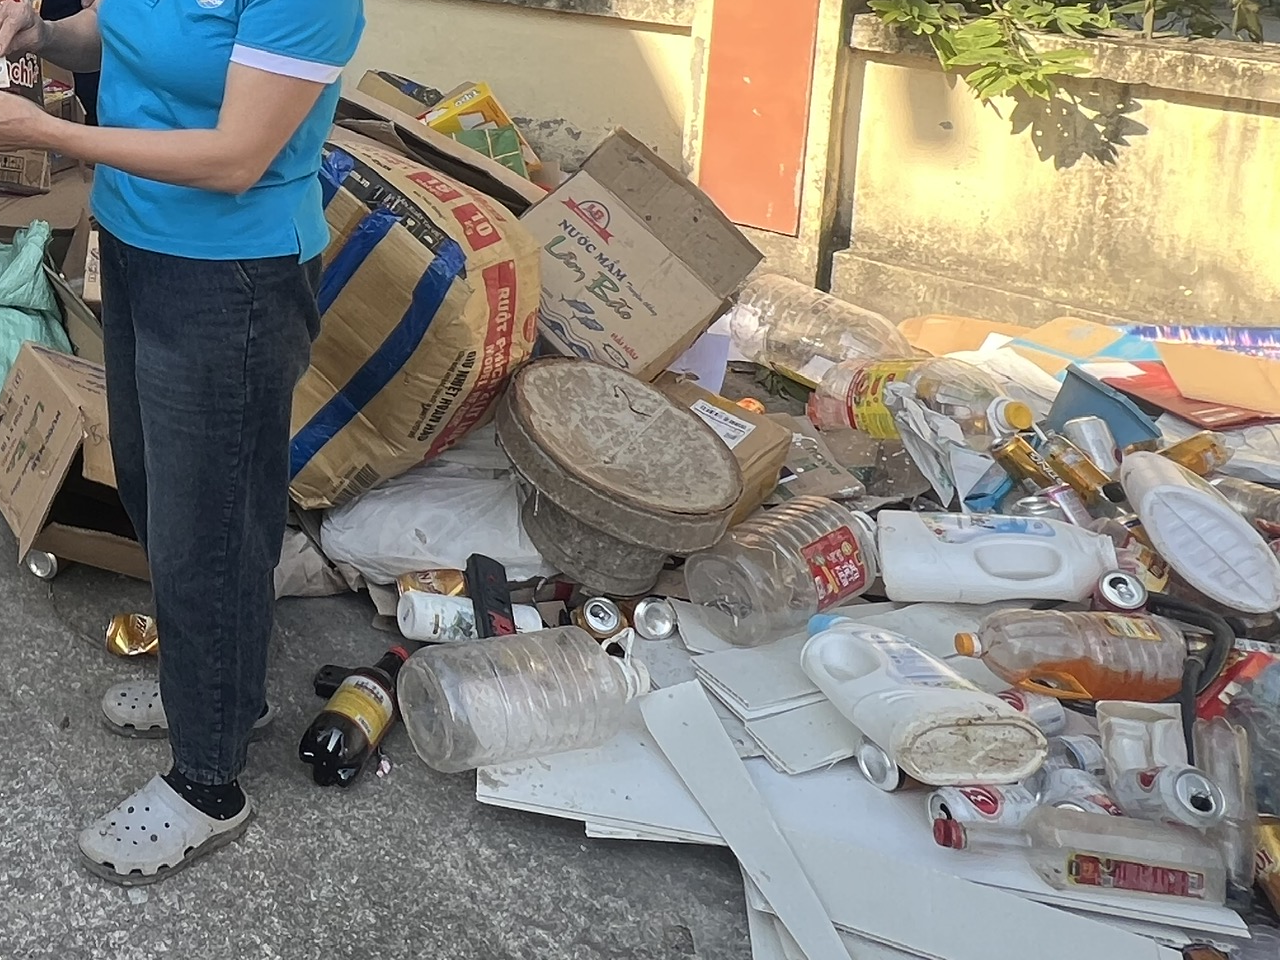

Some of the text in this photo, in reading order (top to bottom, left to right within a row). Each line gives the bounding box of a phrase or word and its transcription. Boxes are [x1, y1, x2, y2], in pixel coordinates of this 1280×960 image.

[472, 209, 493, 238] 10
[558, 219, 628, 282] NƯỚC MẮM
[495, 286, 512, 333] RUỘT
[477, 344, 495, 388] MODEL
